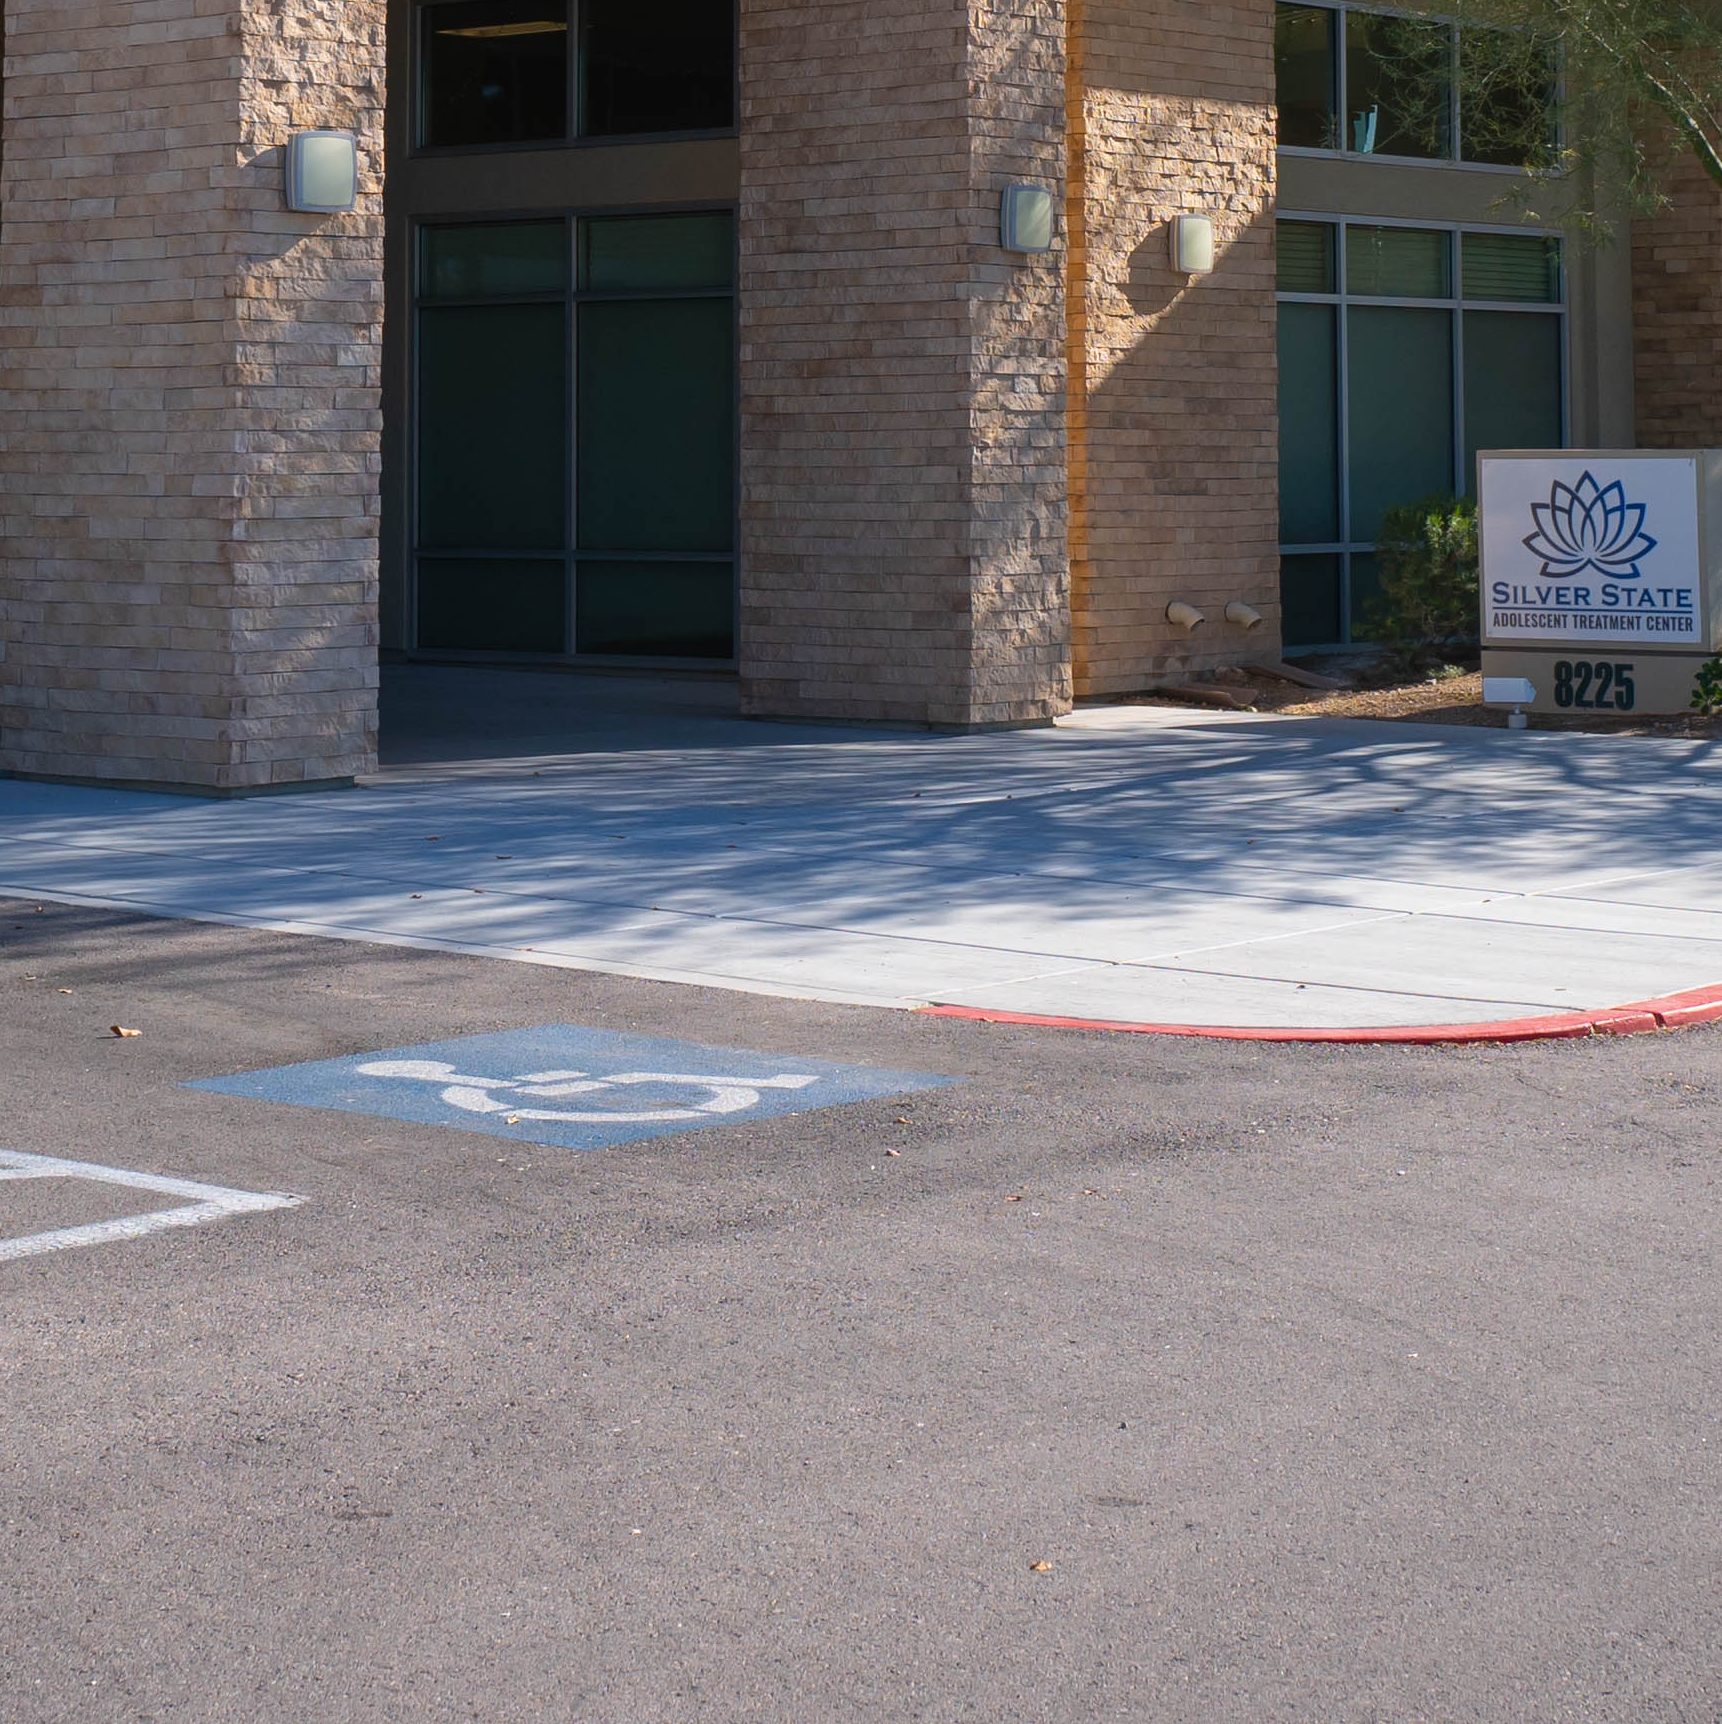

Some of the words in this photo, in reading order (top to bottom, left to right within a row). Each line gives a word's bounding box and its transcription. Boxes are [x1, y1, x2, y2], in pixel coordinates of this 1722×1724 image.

[1492, 581, 1591, 606] SILVER
[1601, 583, 1693, 608] STATE
[1493, 612, 1568, 629] ADOLESCENT
[1572, 613, 1642, 631] TREATMENT
[1646, 615, 1694, 632] CENTER
[1553, 660, 1635, 711] 8225
